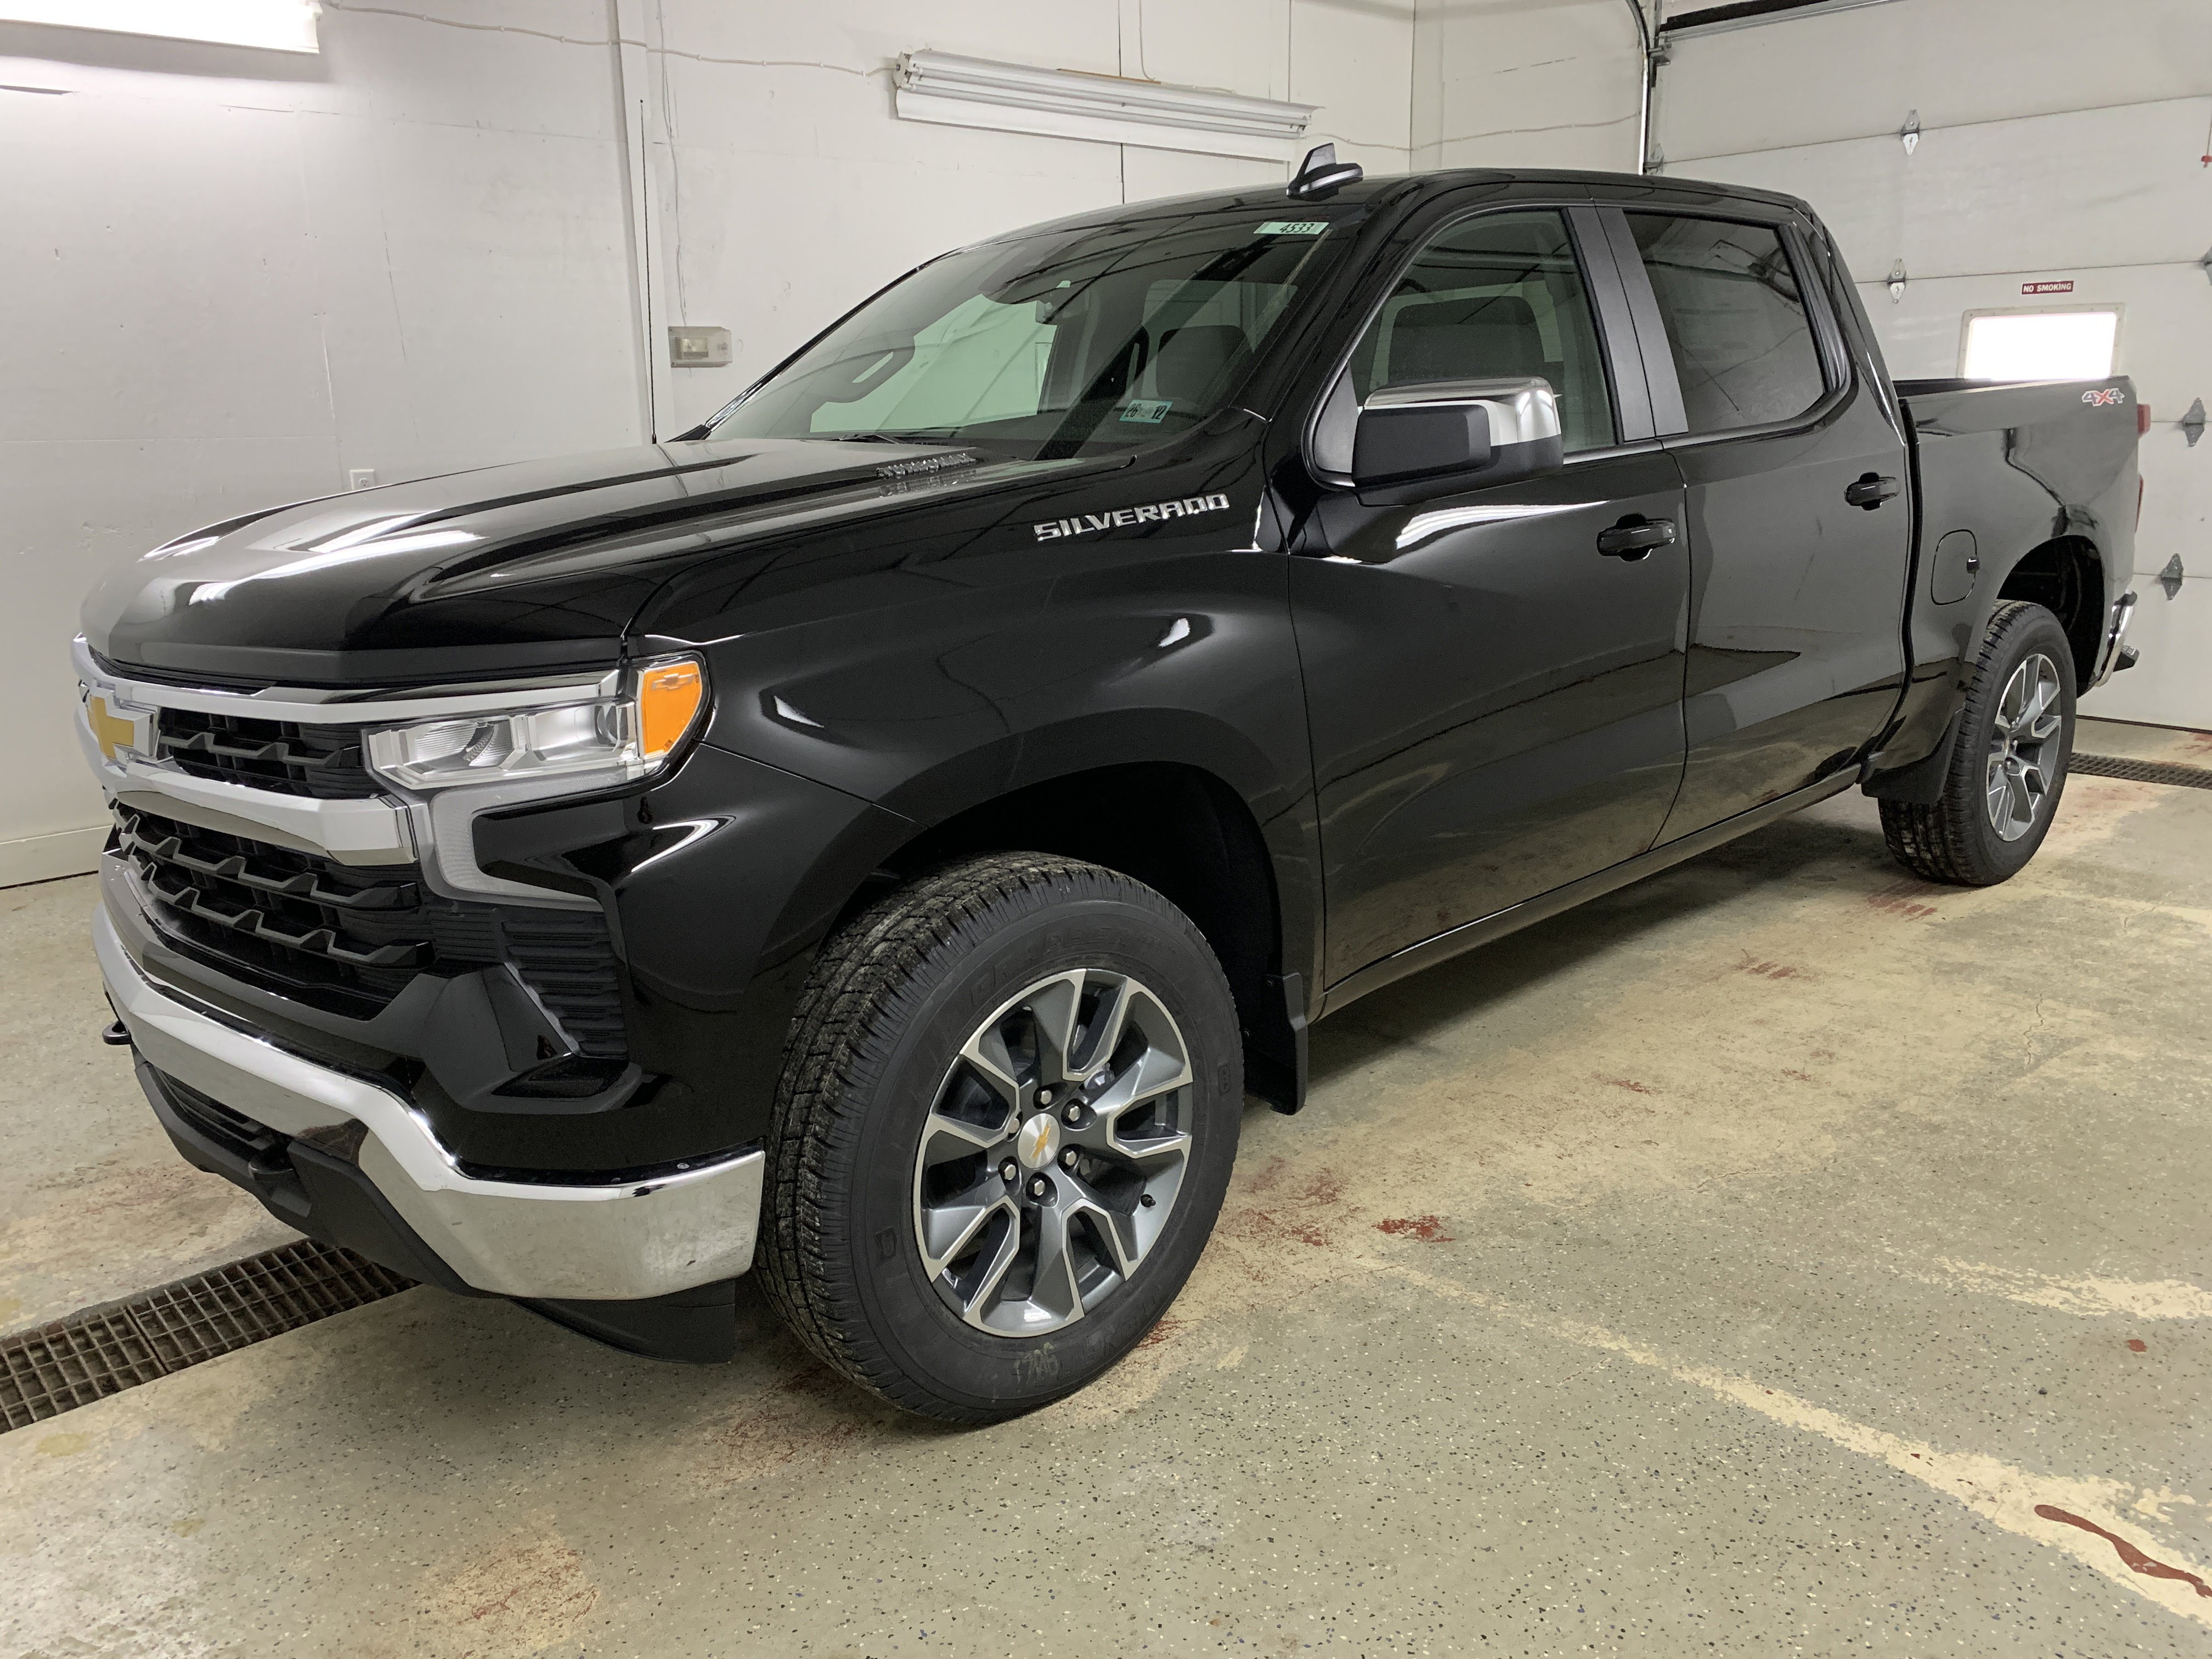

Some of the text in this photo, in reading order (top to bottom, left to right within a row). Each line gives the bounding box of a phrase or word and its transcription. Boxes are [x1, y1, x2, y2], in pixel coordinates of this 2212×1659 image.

[1279, 223, 1315, 233] 4533
[2036, 283, 2072, 292] SMOKING
[1151, 405, 1167, 420] 12
[1034, 493, 1230, 541] SILVERADO
